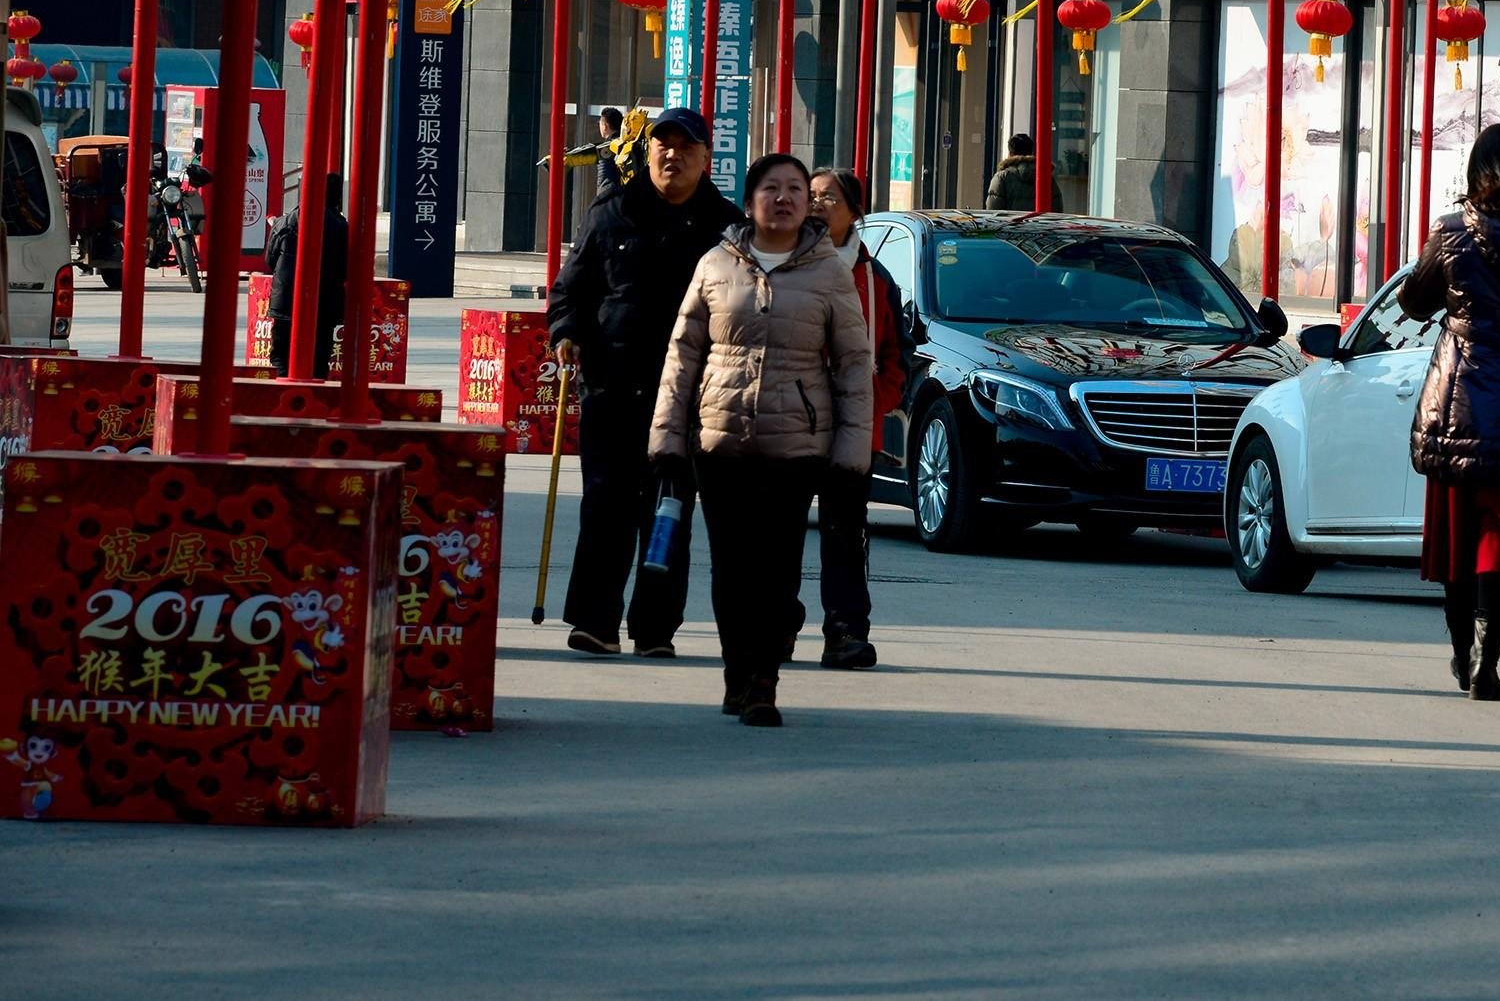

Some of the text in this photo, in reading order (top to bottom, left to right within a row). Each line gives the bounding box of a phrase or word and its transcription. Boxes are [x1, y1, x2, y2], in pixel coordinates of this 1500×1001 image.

[414, 39, 445, 225] 斯维登服务公寓
[469, 358, 496, 381] 2016
[12, 462, 42, 484] 猴
[339, 475, 367, 497] 猴
[99, 527, 273, 585] 宽厚里
[79, 588, 284, 646] 2016
[77, 646, 281, 701] 猴年大吉
[30, 698, 321, 728] HAPPY NEW YEAR!
